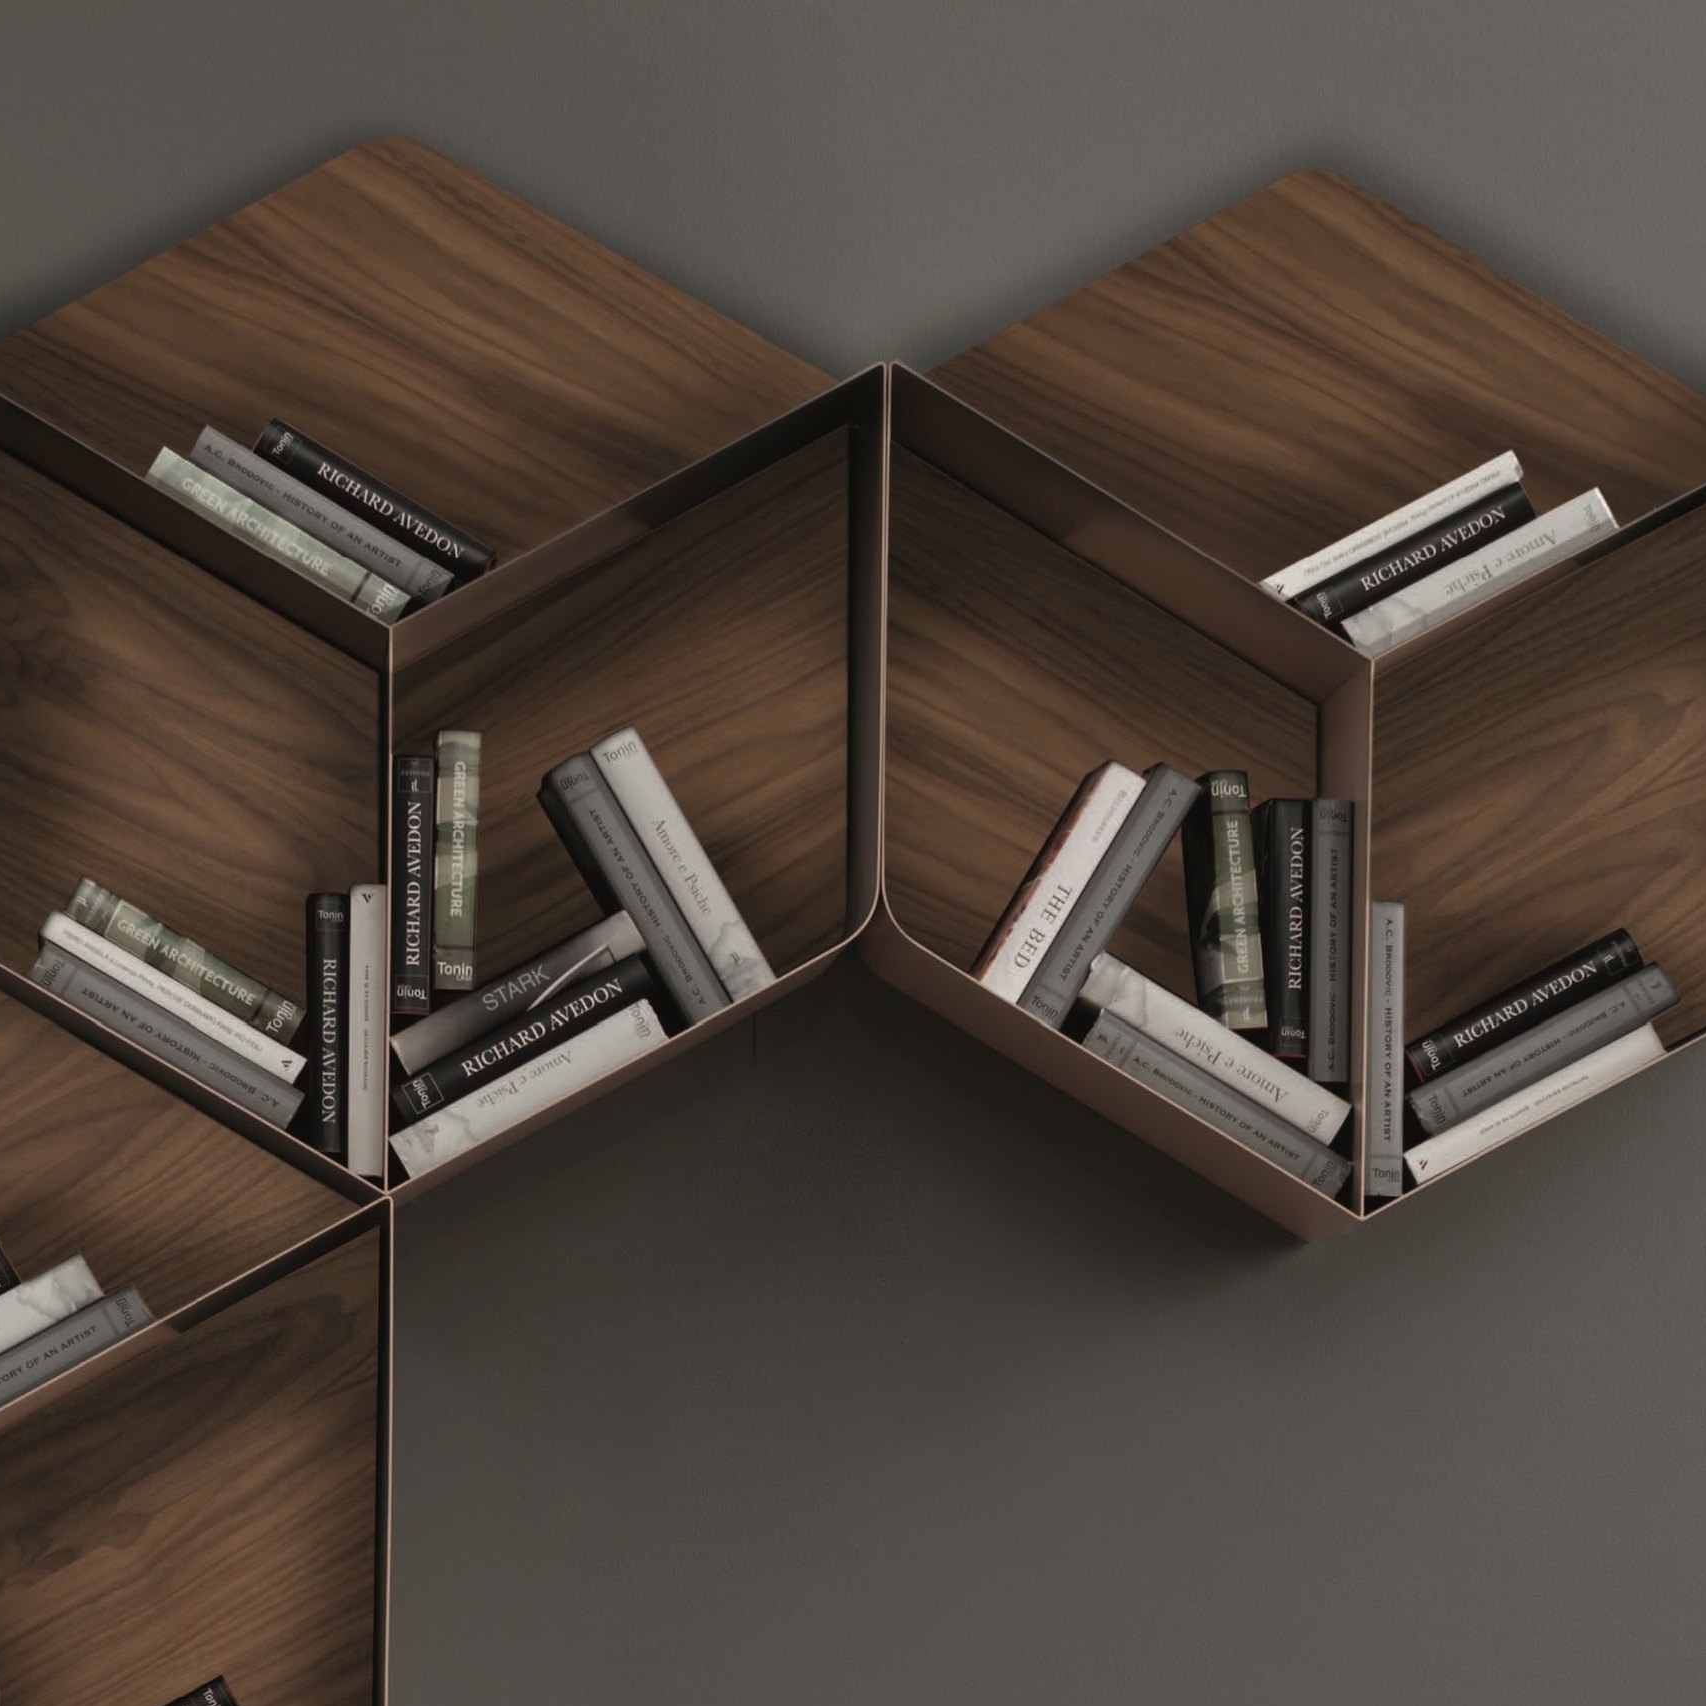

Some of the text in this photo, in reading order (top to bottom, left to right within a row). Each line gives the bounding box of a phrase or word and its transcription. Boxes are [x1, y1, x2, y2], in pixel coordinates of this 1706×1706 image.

[180, 477, 332, 576] GREEN ARCHITECTURE
[316, 461, 465, 559] RICHARD AVEDON
[1360, 542, 1437, 591] RICHARD
[1438, 505, 1506, 551] AVEDON
[1505, 529, 1558, 564] Amore
[1444, 563, 1492, 597] Psiche
[450, 761, 466, 916] GREEN ARCHITECTURE
[405, 801, 421, 965] RICHARD AVEDON
[1226, 819, 1248, 973] GREEN ARCHITECTURE
[1287, 826, 1303, 988] RICHARD AVEDON
[116, 918, 256, 1005] GREEN ARCHITECTURE
[1013, 884, 1072, 969] THE BED
[460, 978, 623, 1076] RICHARD AVEDON
[481, 964, 550, 1011] STARK
[1452, 960, 1597, 1047] RICHARD AVEDON
[321, 958, 336, 1122] RICHARD AVEDON
[1173, 1027, 1222, 1065] Psiche
[1384, 1007, 1392, 1058] HISTORY
[1384, 1061, 1391, 1077] OF
[1235, 1064, 1288, 1104] Amore
[1383, 1081, 1391, 1097] AN
[1383, 1101, 1391, 1141] ARTIST
[25, 1356, 40, 1369] OF
[42, 1346, 58, 1360] AN
[59, 1325, 96, 1350] ARTIST
